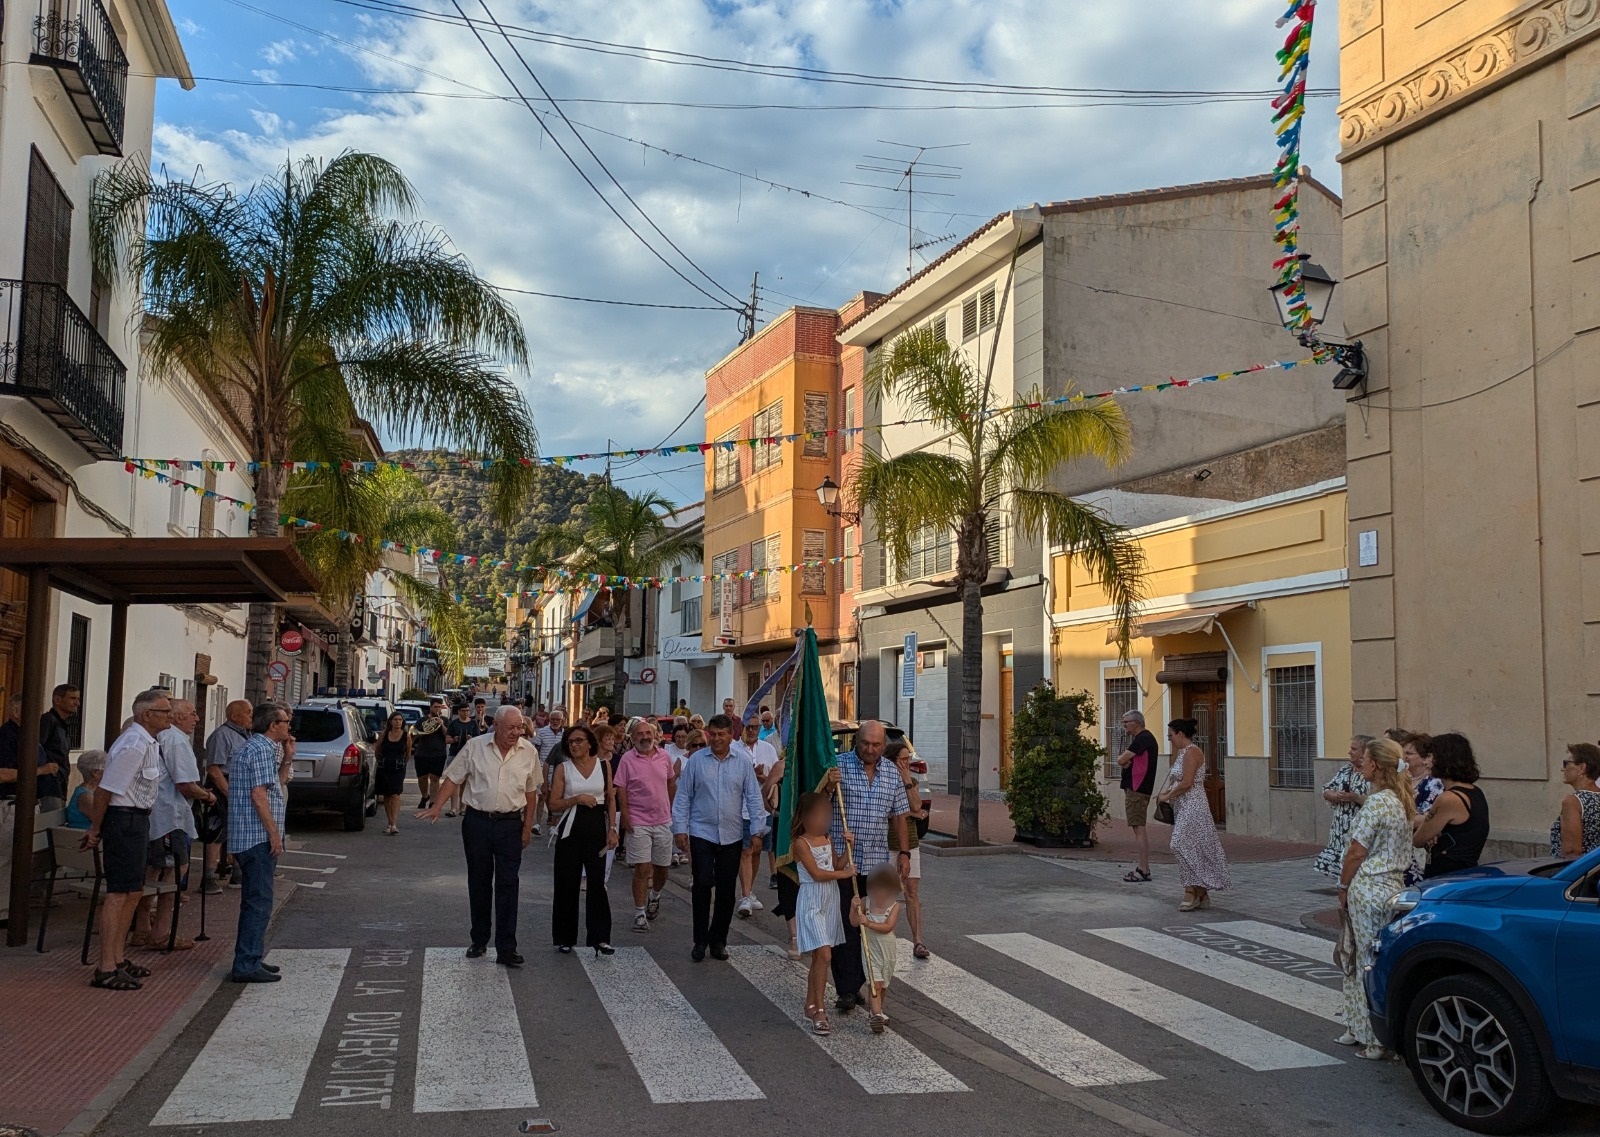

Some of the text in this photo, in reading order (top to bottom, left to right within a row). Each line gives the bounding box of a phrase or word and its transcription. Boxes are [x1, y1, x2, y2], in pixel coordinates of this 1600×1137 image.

[361, 949, 414, 968] PER
[1162, 925, 1344, 979] DIVERSIDAD
[353, 980, 407, 997] LA
[319, 1011, 402, 1110] DIVERSITAT
